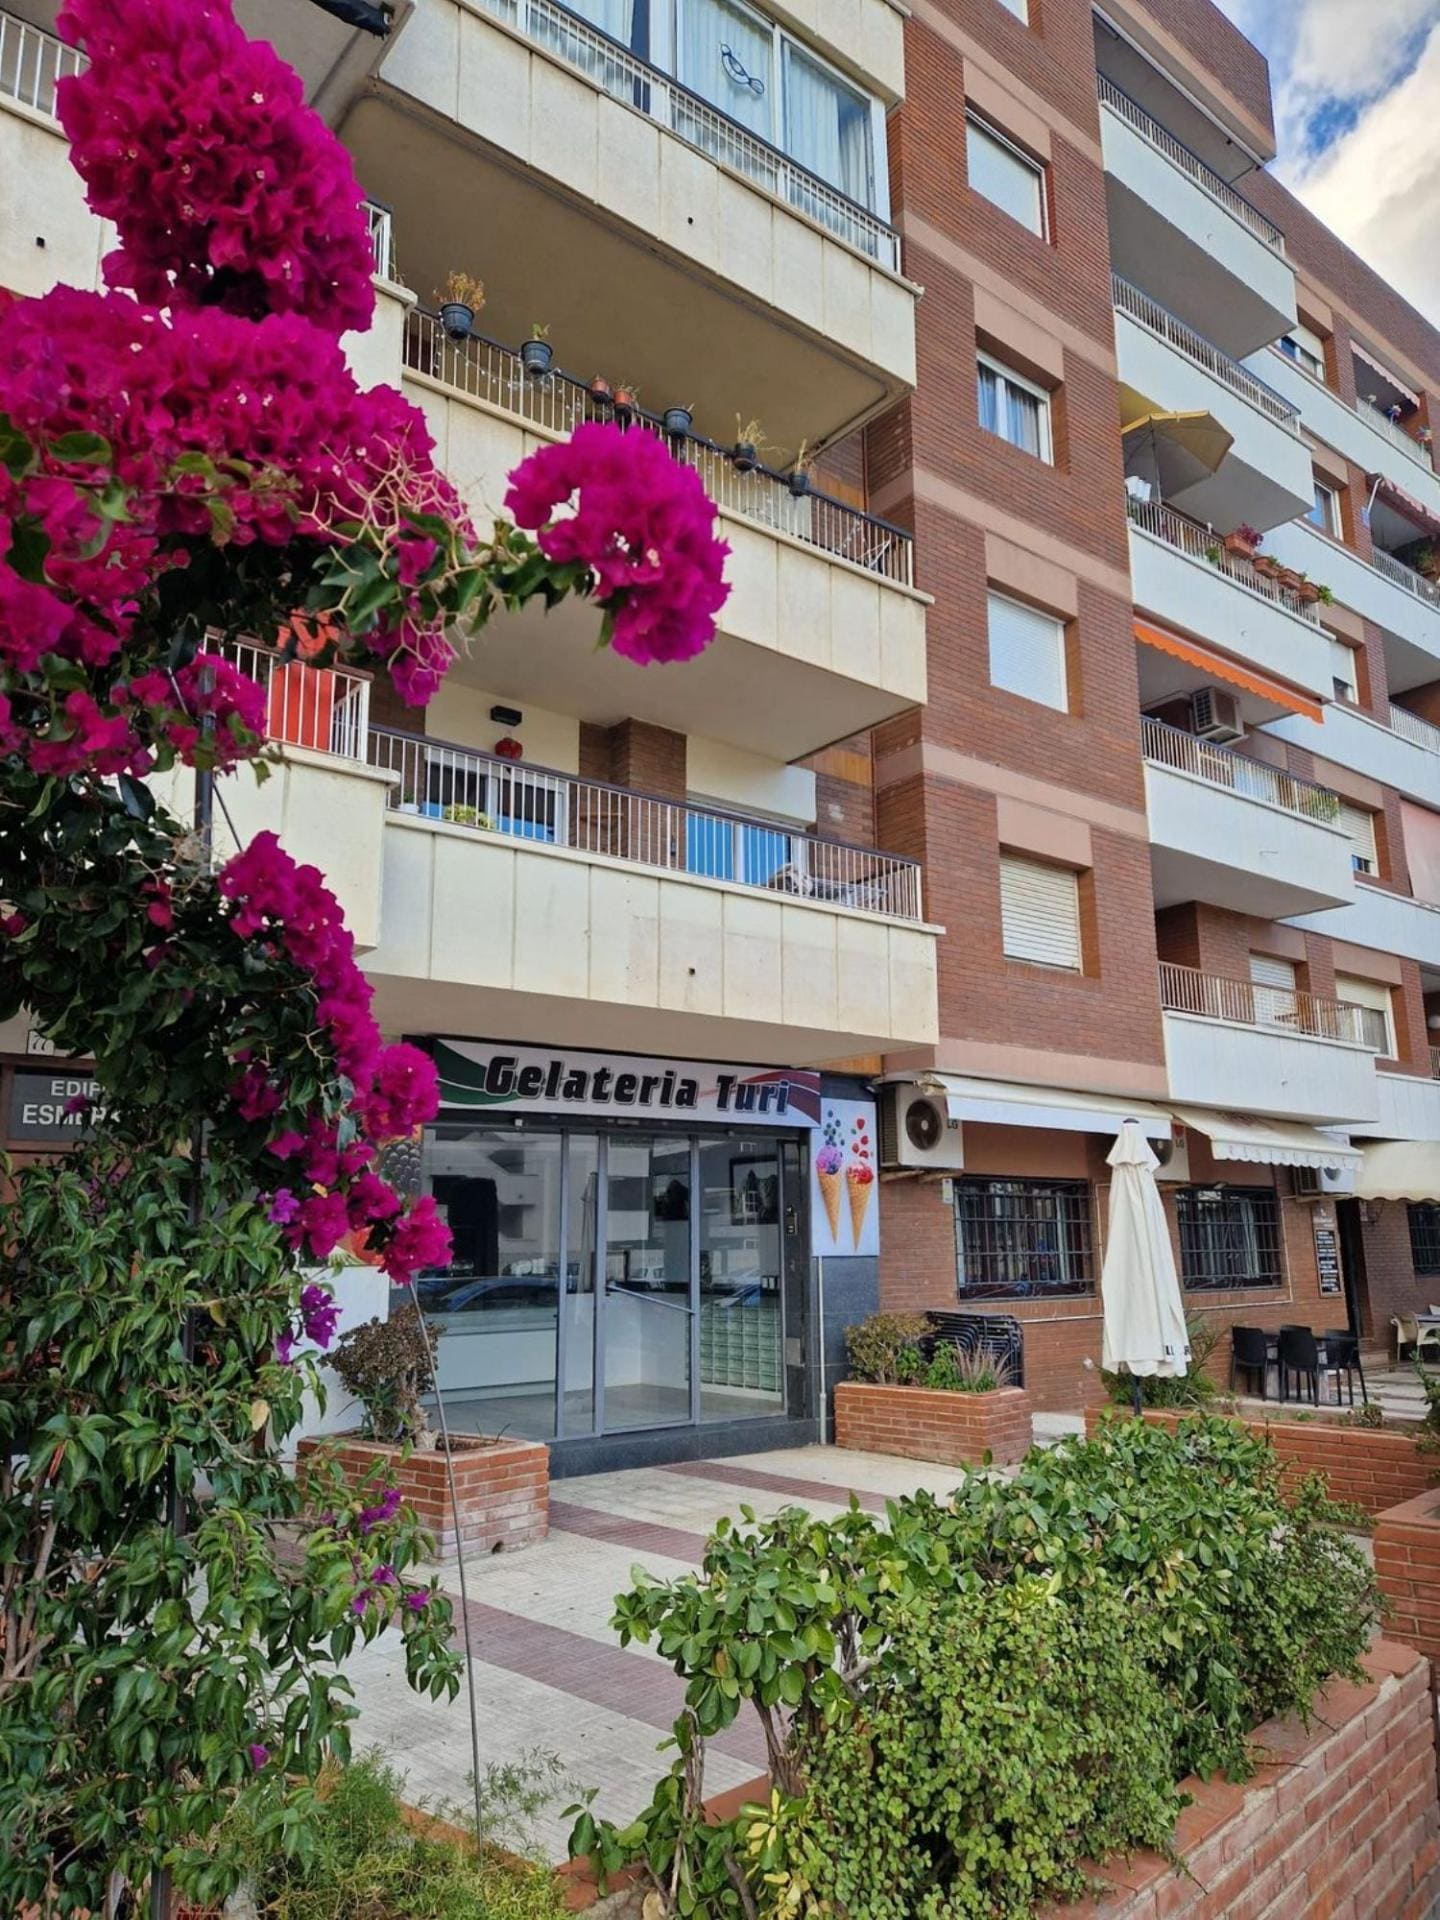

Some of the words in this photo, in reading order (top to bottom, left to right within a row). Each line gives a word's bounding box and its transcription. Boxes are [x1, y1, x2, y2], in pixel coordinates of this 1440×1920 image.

[51, 1080, 106, 1097] EDIF
[483, 1055, 698, 1108] Gelateria
[716, 1074, 791, 1115] Turi
